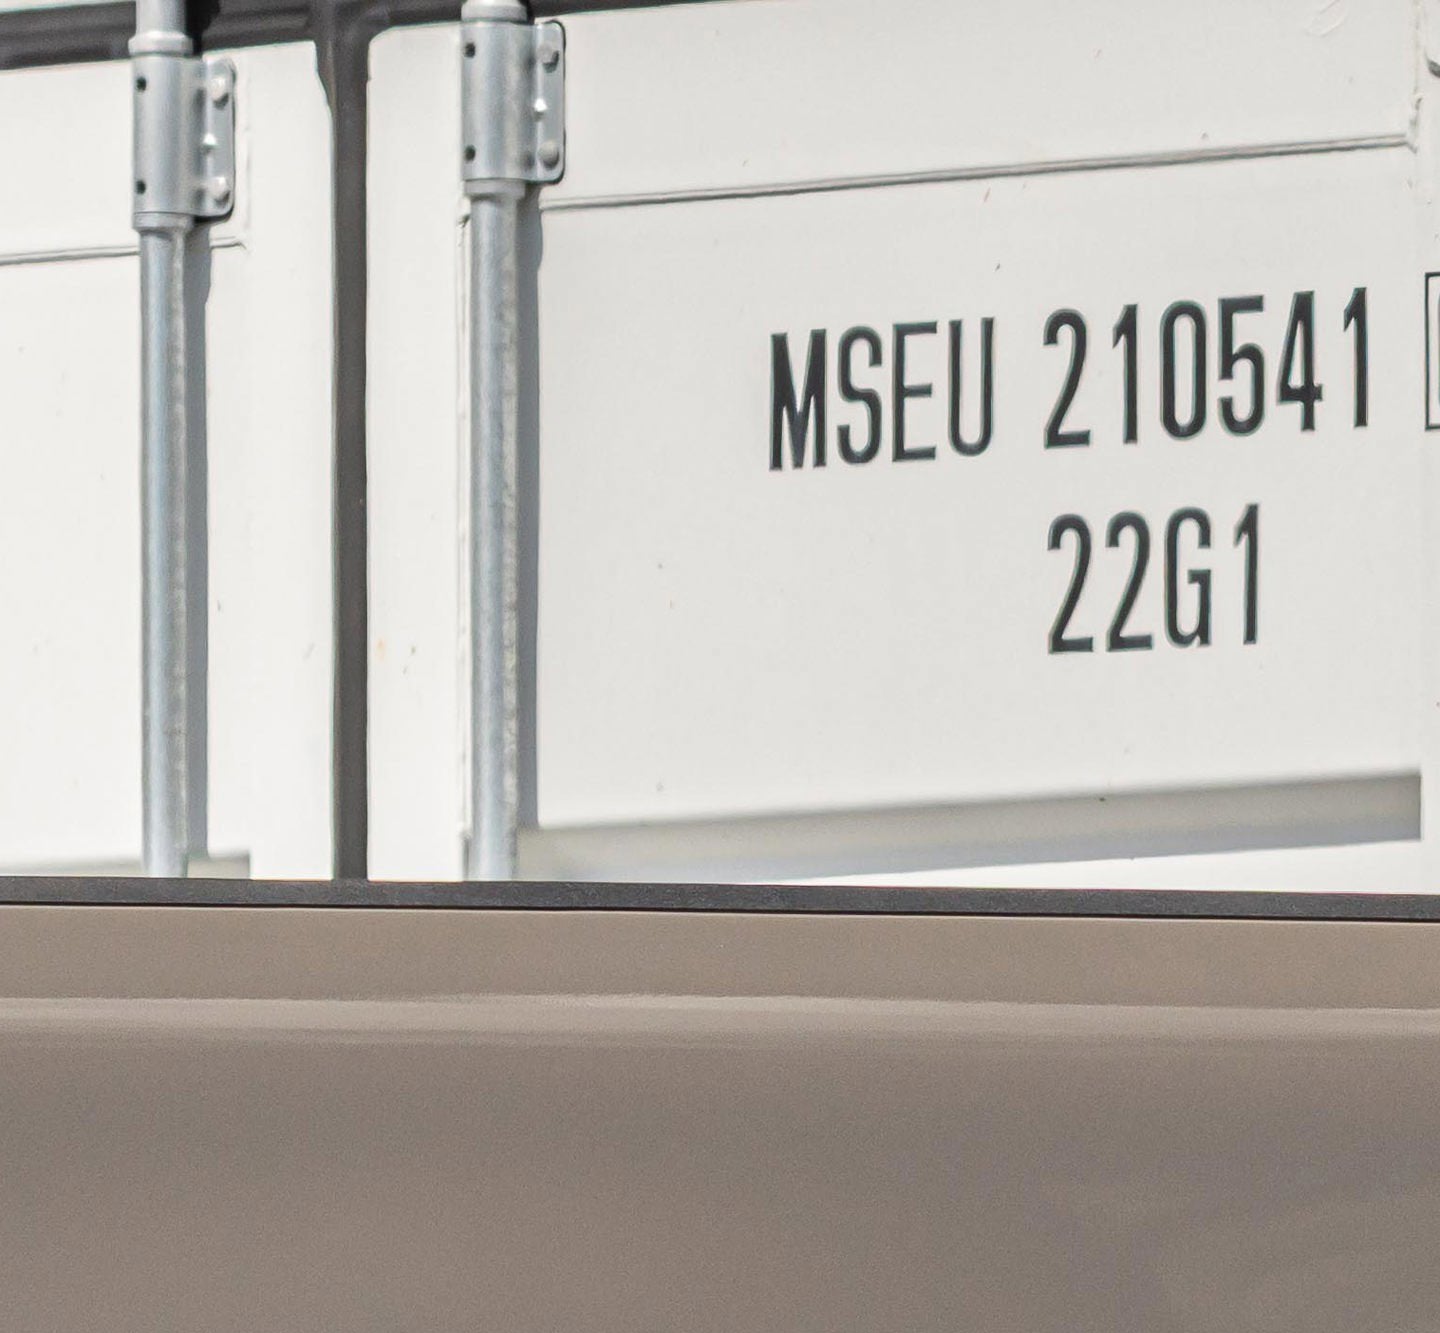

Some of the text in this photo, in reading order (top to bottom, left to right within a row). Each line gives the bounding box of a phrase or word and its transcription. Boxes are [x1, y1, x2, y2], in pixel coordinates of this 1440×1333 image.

[770, 318, 994, 470] MSEU
[1044, 288, 1367, 449] 210541
[1048, 504, 1258, 654] 22G1
